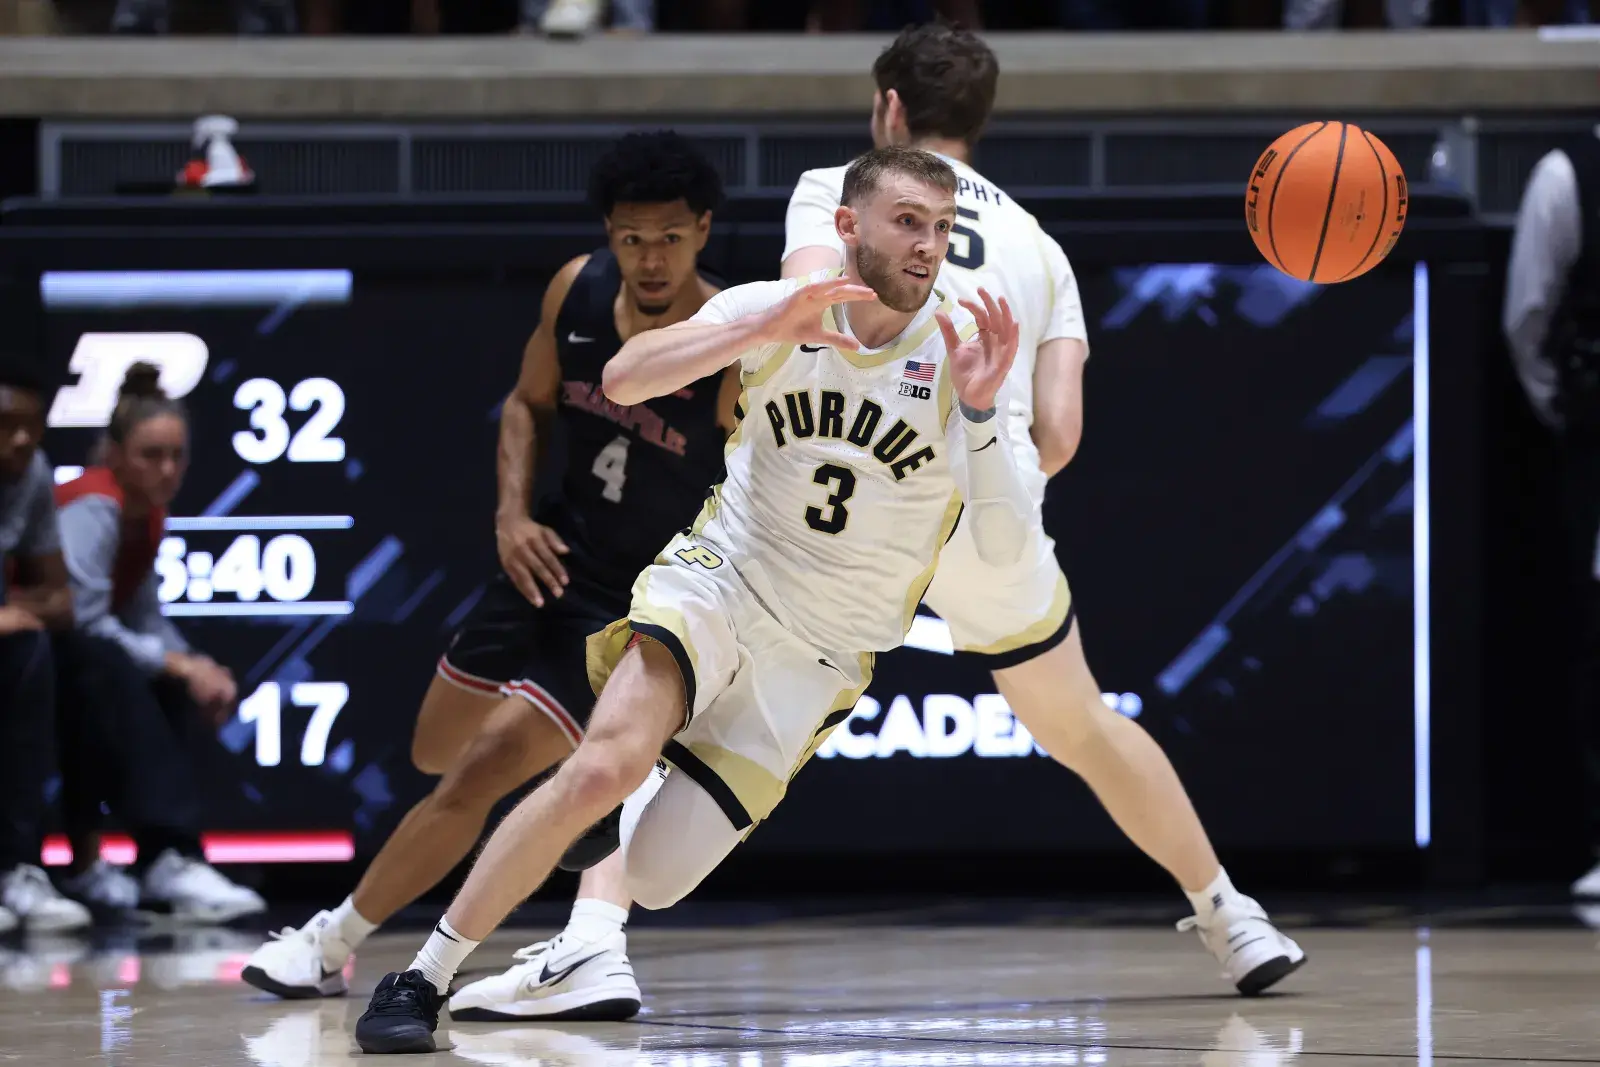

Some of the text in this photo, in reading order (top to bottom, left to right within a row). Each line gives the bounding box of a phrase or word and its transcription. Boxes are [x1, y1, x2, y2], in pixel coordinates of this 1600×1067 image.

[957, 176, 1002, 206] PHY
[945, 205, 985, 271] 5
[47, 332, 209, 428] P
[898, 381, 932, 400] BIG
[231, 377, 346, 463] 32
[763, 387, 937, 483] PURDUE
[591, 434, 632, 503] 4
[803, 461, 857, 535] 3
[674, 544, 724, 570] P
[238, 681, 350, 767] 17
